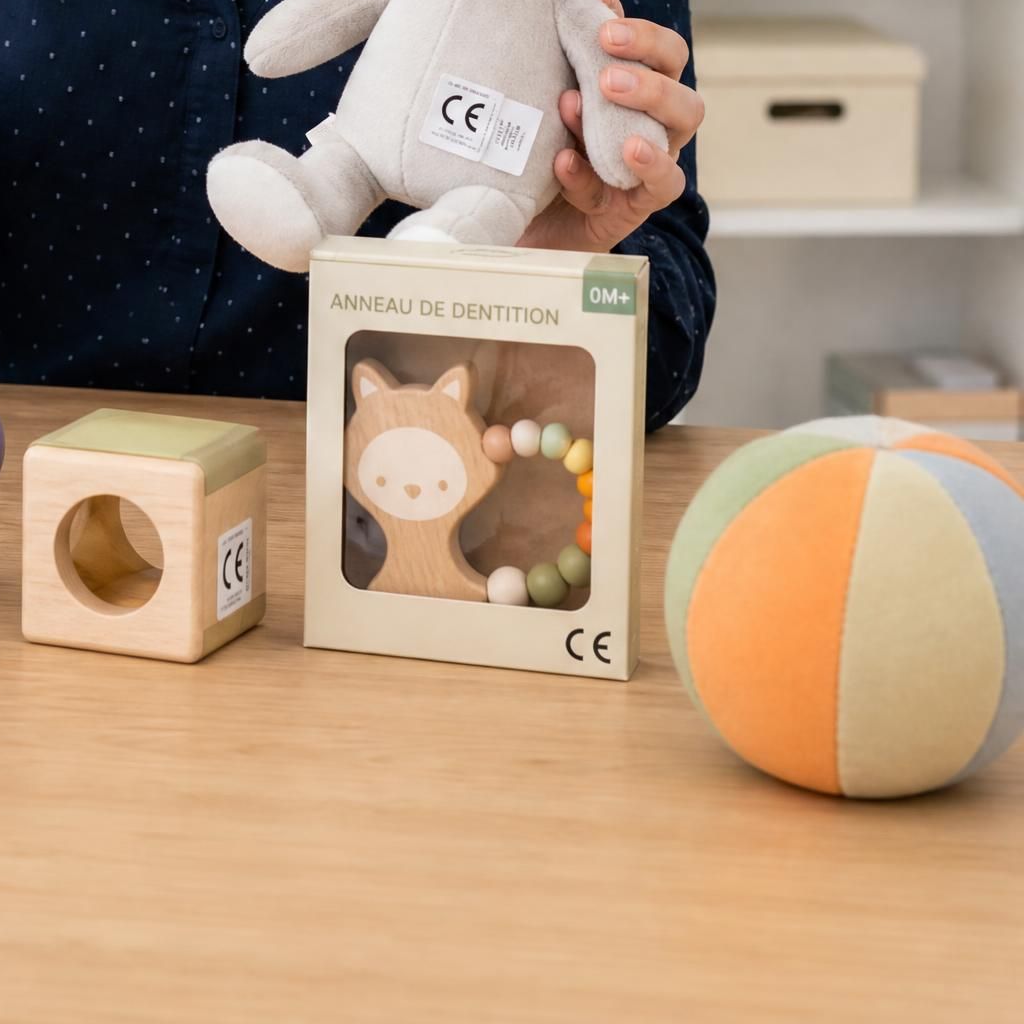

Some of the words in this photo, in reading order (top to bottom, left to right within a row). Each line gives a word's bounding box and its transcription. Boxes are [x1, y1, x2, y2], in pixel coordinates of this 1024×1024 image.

[442, 95, 485, 132] CE
[330, 293, 412, 314] ANNEAU
[420, 300, 445, 317] DE
[453, 302, 559, 326] DENTITION
[223, 542, 243, 589] CE
[566, 629, 611, 664] CE
